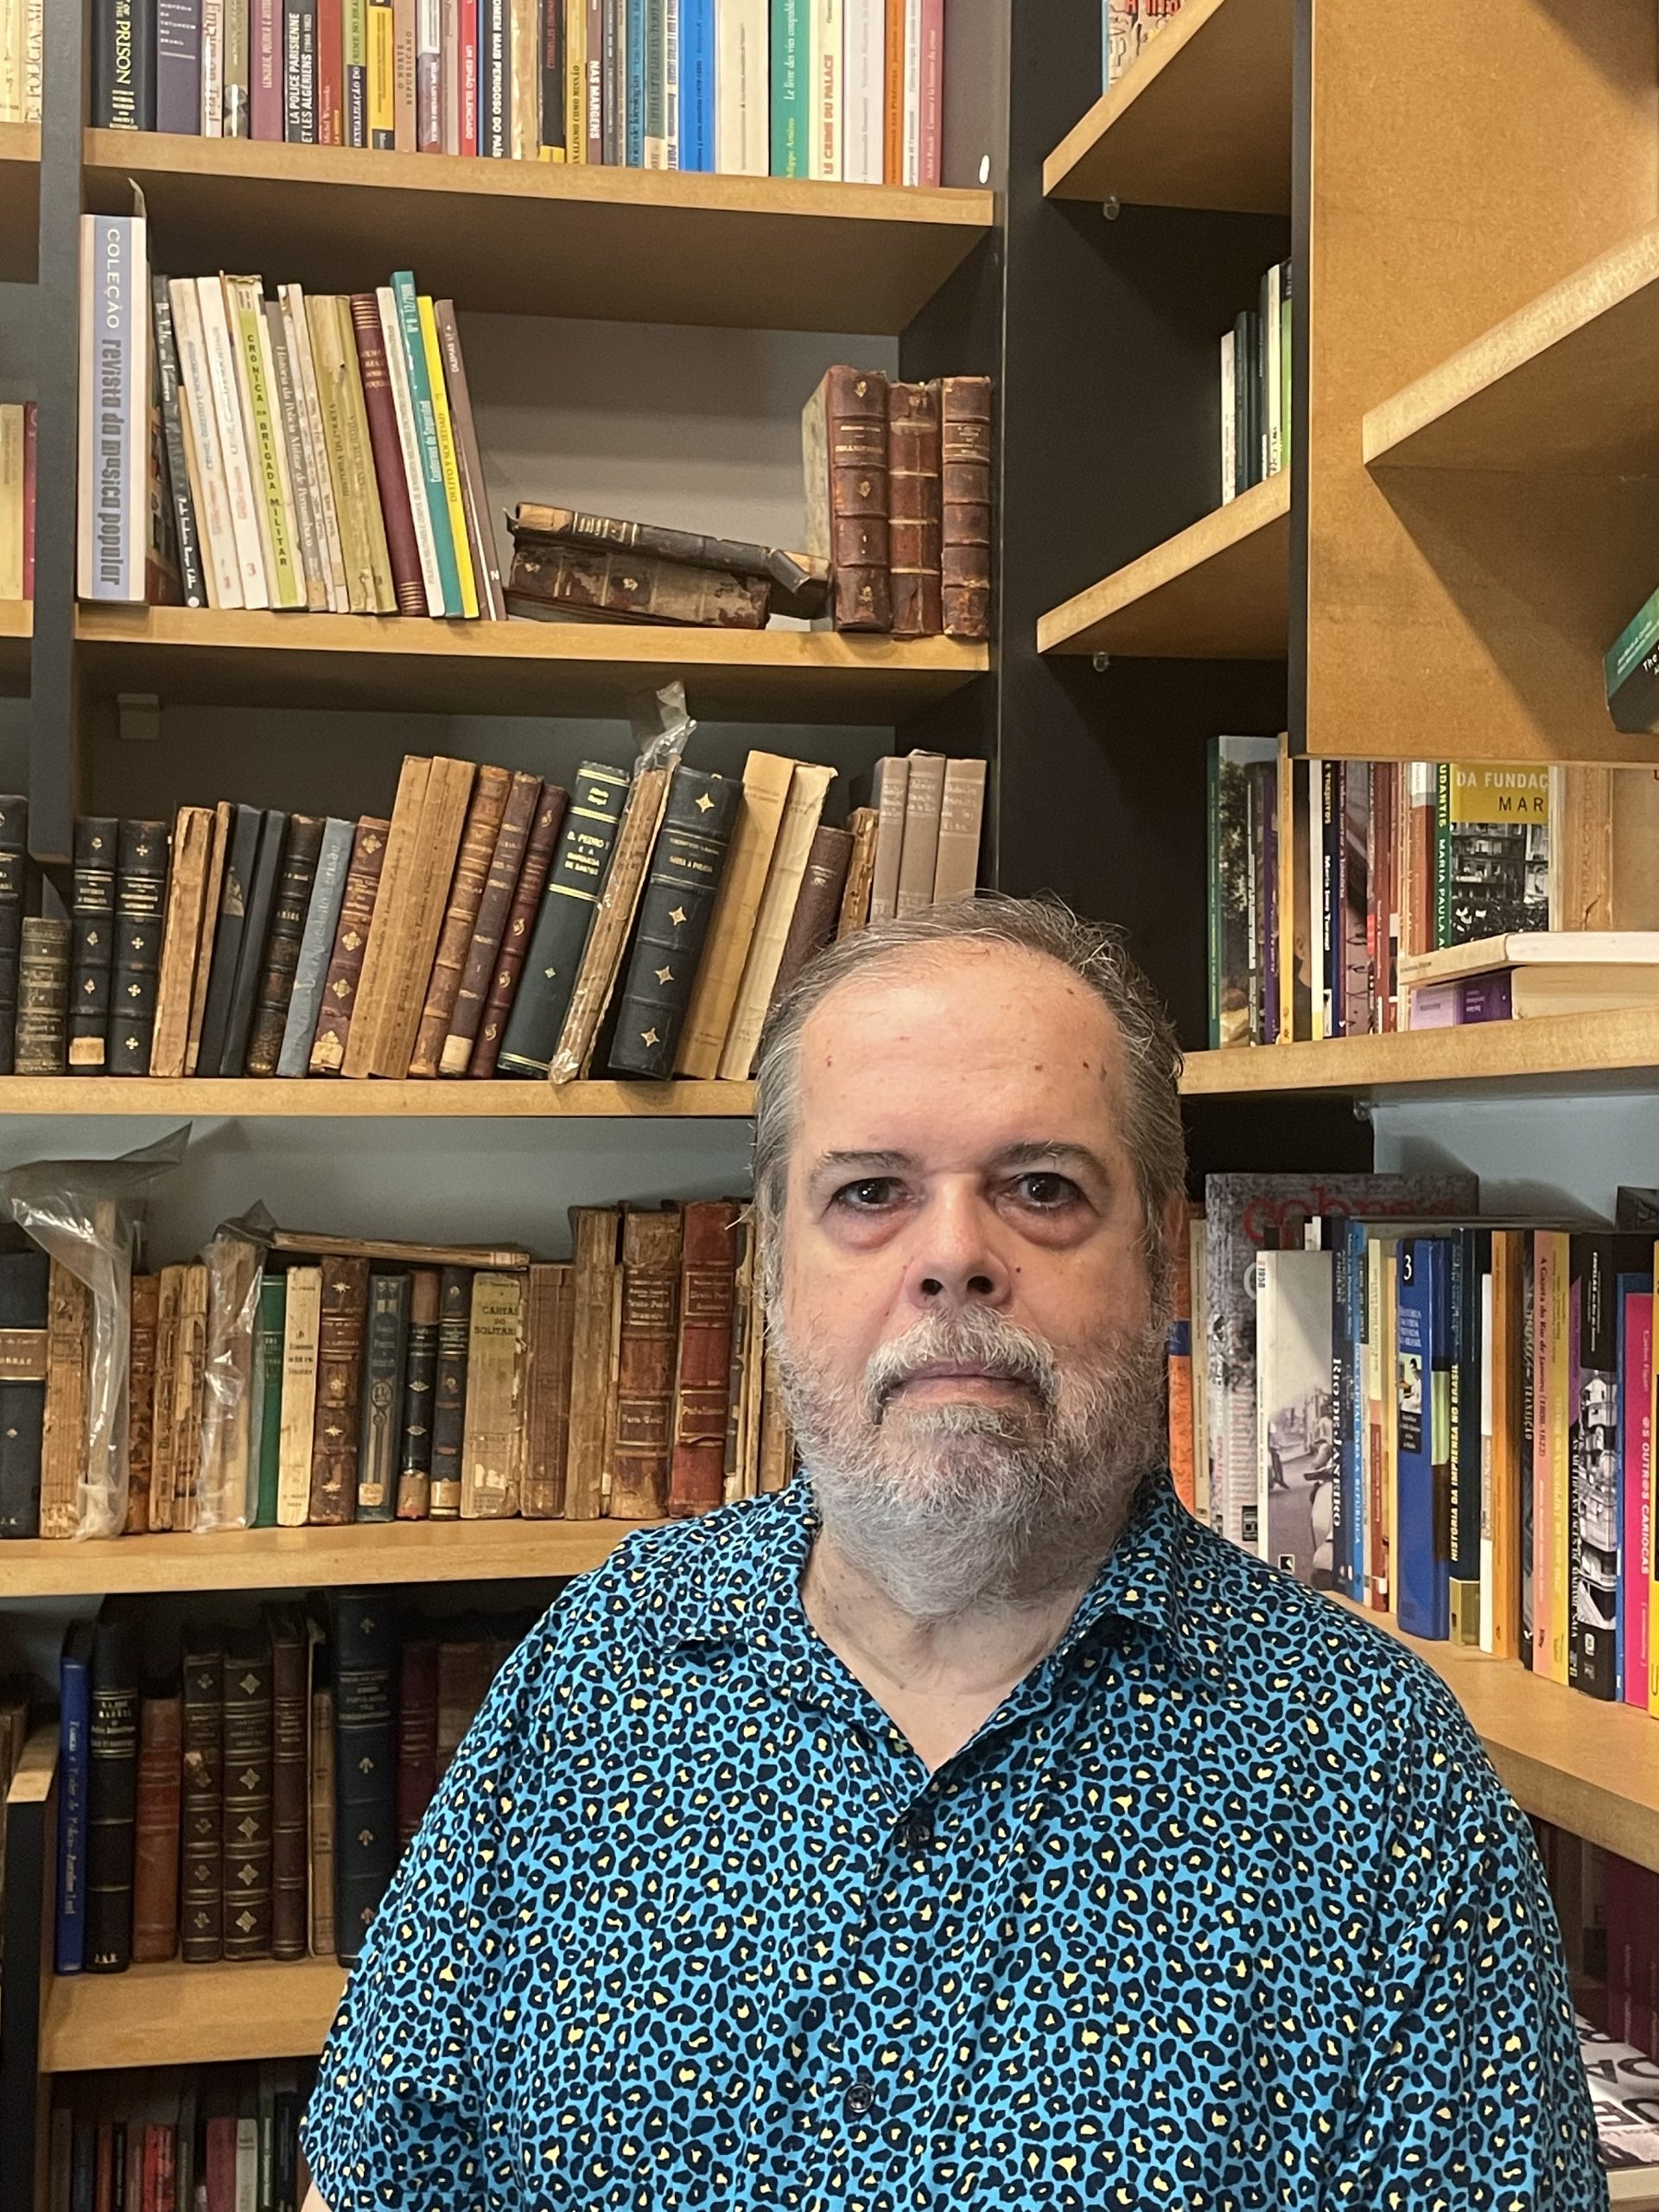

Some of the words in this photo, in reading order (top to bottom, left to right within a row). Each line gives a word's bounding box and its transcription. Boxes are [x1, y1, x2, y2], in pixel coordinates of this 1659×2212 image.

[493, 0, 502, 31] OMEM
[116, 20, 131, 85] PRISON
[289, 13, 300, 73] PARISIENNE
[493, 33, 502, 60] MAIS
[784, 37, 795, 53] vies
[353, 67, 361, 79] DO
[589, 60, 601, 84] NAS
[784, 54, 795, 69] des
[299, 54, 313, 110] ALGÉRIENS
[493, 61, 503, 115] PERIGOSO
[784, 70, 795, 89] livre
[823, 54, 834, 99] PALACE
[289, 74, 300, 110] POLICE
[784, 90, 795, 100] Le
[289, 111, 300, 124] LA
[302, 111, 313, 129] LES
[589, 86, 601, 139] MARGENS
[823, 102, 834, 119] DU
[302, 130, 313, 143] ET
[493, 117, 502, 133] DO
[493, 135, 504, 158] PAÍS
[823, 121, 834, 159] CRIME
[785, 150, 797, 179] hilippe
[823, 162, 834, 175] LE
[106, 227, 122, 330] COLEÇÃO
[101, 338, 123, 409] revista
[100, 412, 125, 436] da
[247, 334, 264, 404] CRONICA
[259, 422, 276, 491] BRIGADA
[270, 498, 288, 567] MILITAR
[437, 413, 453, 464] SOCIEDAD
[97, 512, 124, 587] popular
[245, 563, 257, 578] 3
[1456, 771, 1477, 788] DA
[1498, 796, 1544, 813] MAR
[578, 833, 604, 849] PEDRO
[1438, 838, 1446, 883] MARIA
[1437, 887, 1446, 932] PAULA
[1402, 1254, 1414, 1281] 3
[1540, 1304, 1548, 1319] do
[1540, 1320, 1548, 1338] Rio
[1540, 1340, 1548, 1353] de
[1332, 1357, 1343, 1393] RIO
[1450, 1364, 1459, 1406] BRASIL
[1450, 1408, 1459, 1426] NO
[1450, 1427, 1459, 1487] IMPRENSA
[1641, 1441, 1650, 1499] OUTR@S
[1332, 1421, 1343, 1526] JANEIRO
[1450, 1489, 1459, 1505] DA
[1449, 1507, 1459, 1563] HISTÓRIA
[1641, 1503, 1650, 1573] CARIOCAS
